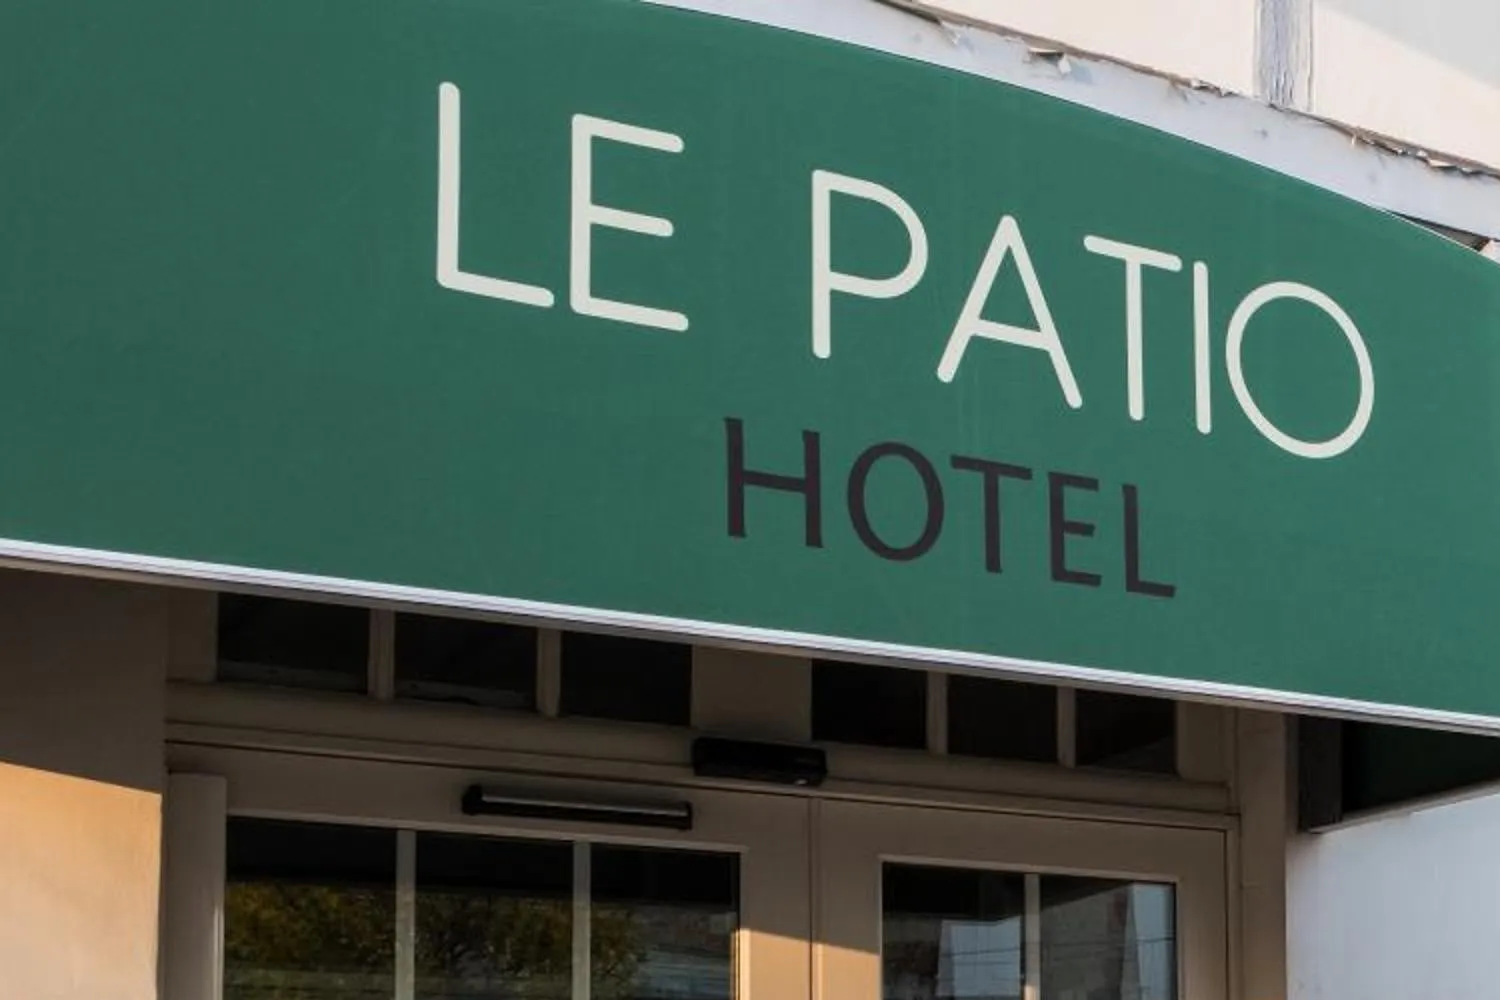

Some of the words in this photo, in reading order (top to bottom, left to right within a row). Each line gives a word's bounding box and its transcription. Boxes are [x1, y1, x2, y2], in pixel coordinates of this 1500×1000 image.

[436, 82, 689, 331] LE
[812, 169, 1375, 459] PATIO
[723, 416, 1176, 598] HOTEL
